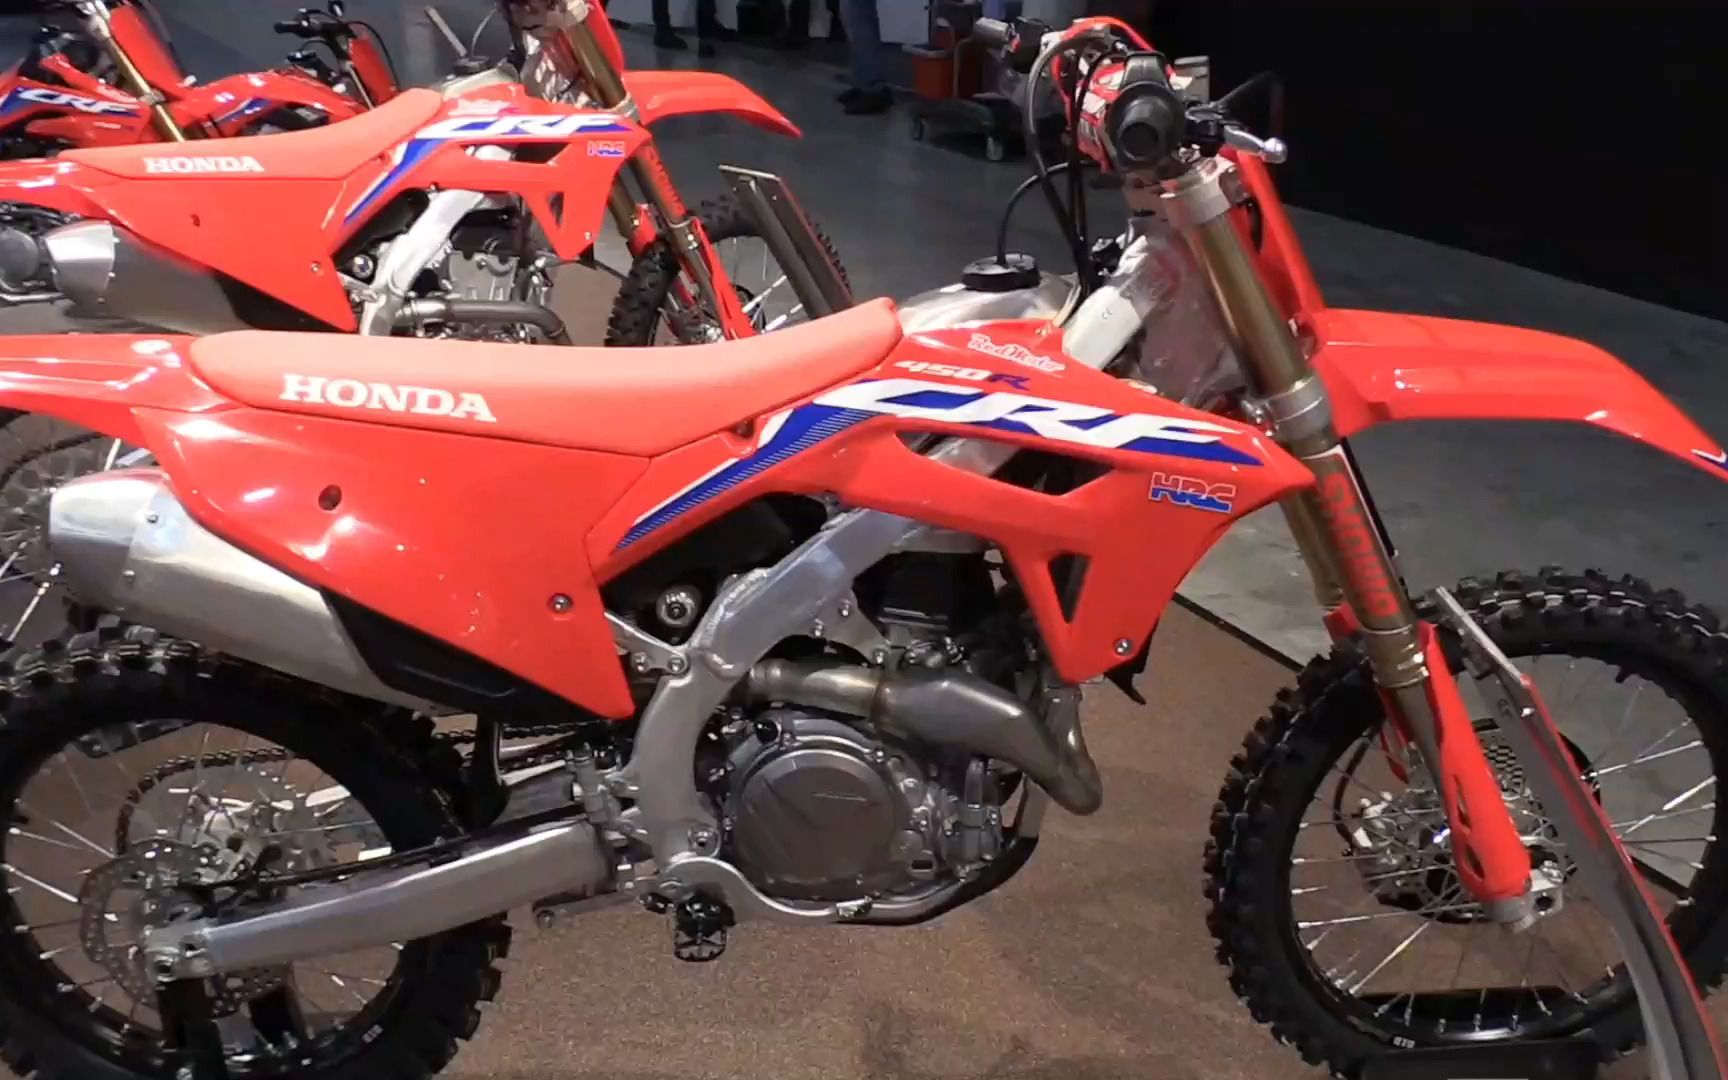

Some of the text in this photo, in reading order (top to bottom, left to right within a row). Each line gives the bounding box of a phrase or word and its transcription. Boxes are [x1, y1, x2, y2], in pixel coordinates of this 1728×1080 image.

[17, 87, 140, 113] CRF
[416, 113, 623, 138] CRF
[143, 155, 265, 174] HONDA
[967, 333, 1066, 372] RedMoto
[894, 360, 1031, 391] 450R
[279, 373, 497, 422] HONDA
[814, 378, 1243, 448] CRF
[1148, 472, 1238, 514] HRC
